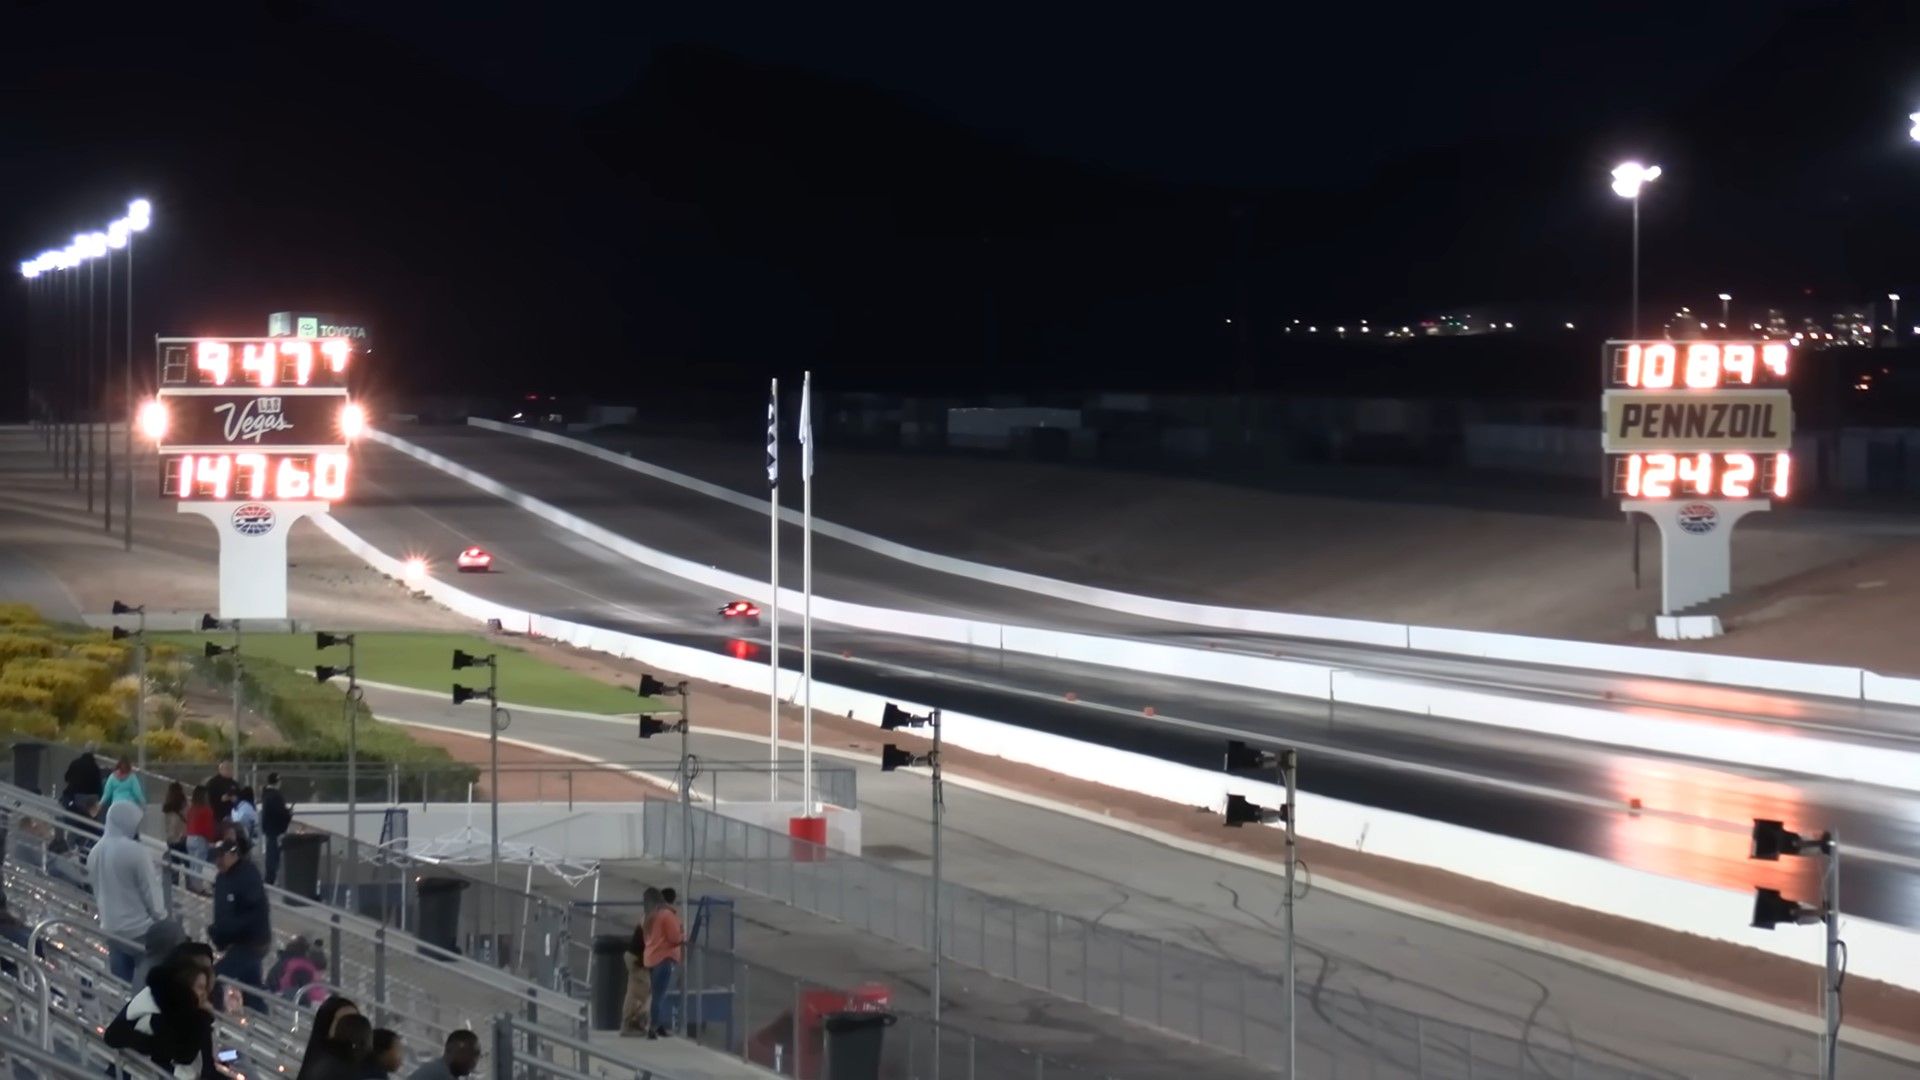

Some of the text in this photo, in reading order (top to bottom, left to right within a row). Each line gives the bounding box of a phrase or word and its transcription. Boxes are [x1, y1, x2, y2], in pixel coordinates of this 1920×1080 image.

[320, 325, 365, 338] TOYOTA
[214, 401, 294, 443] Vegas
[1619, 403, 1776, 439] PENNZOIL
